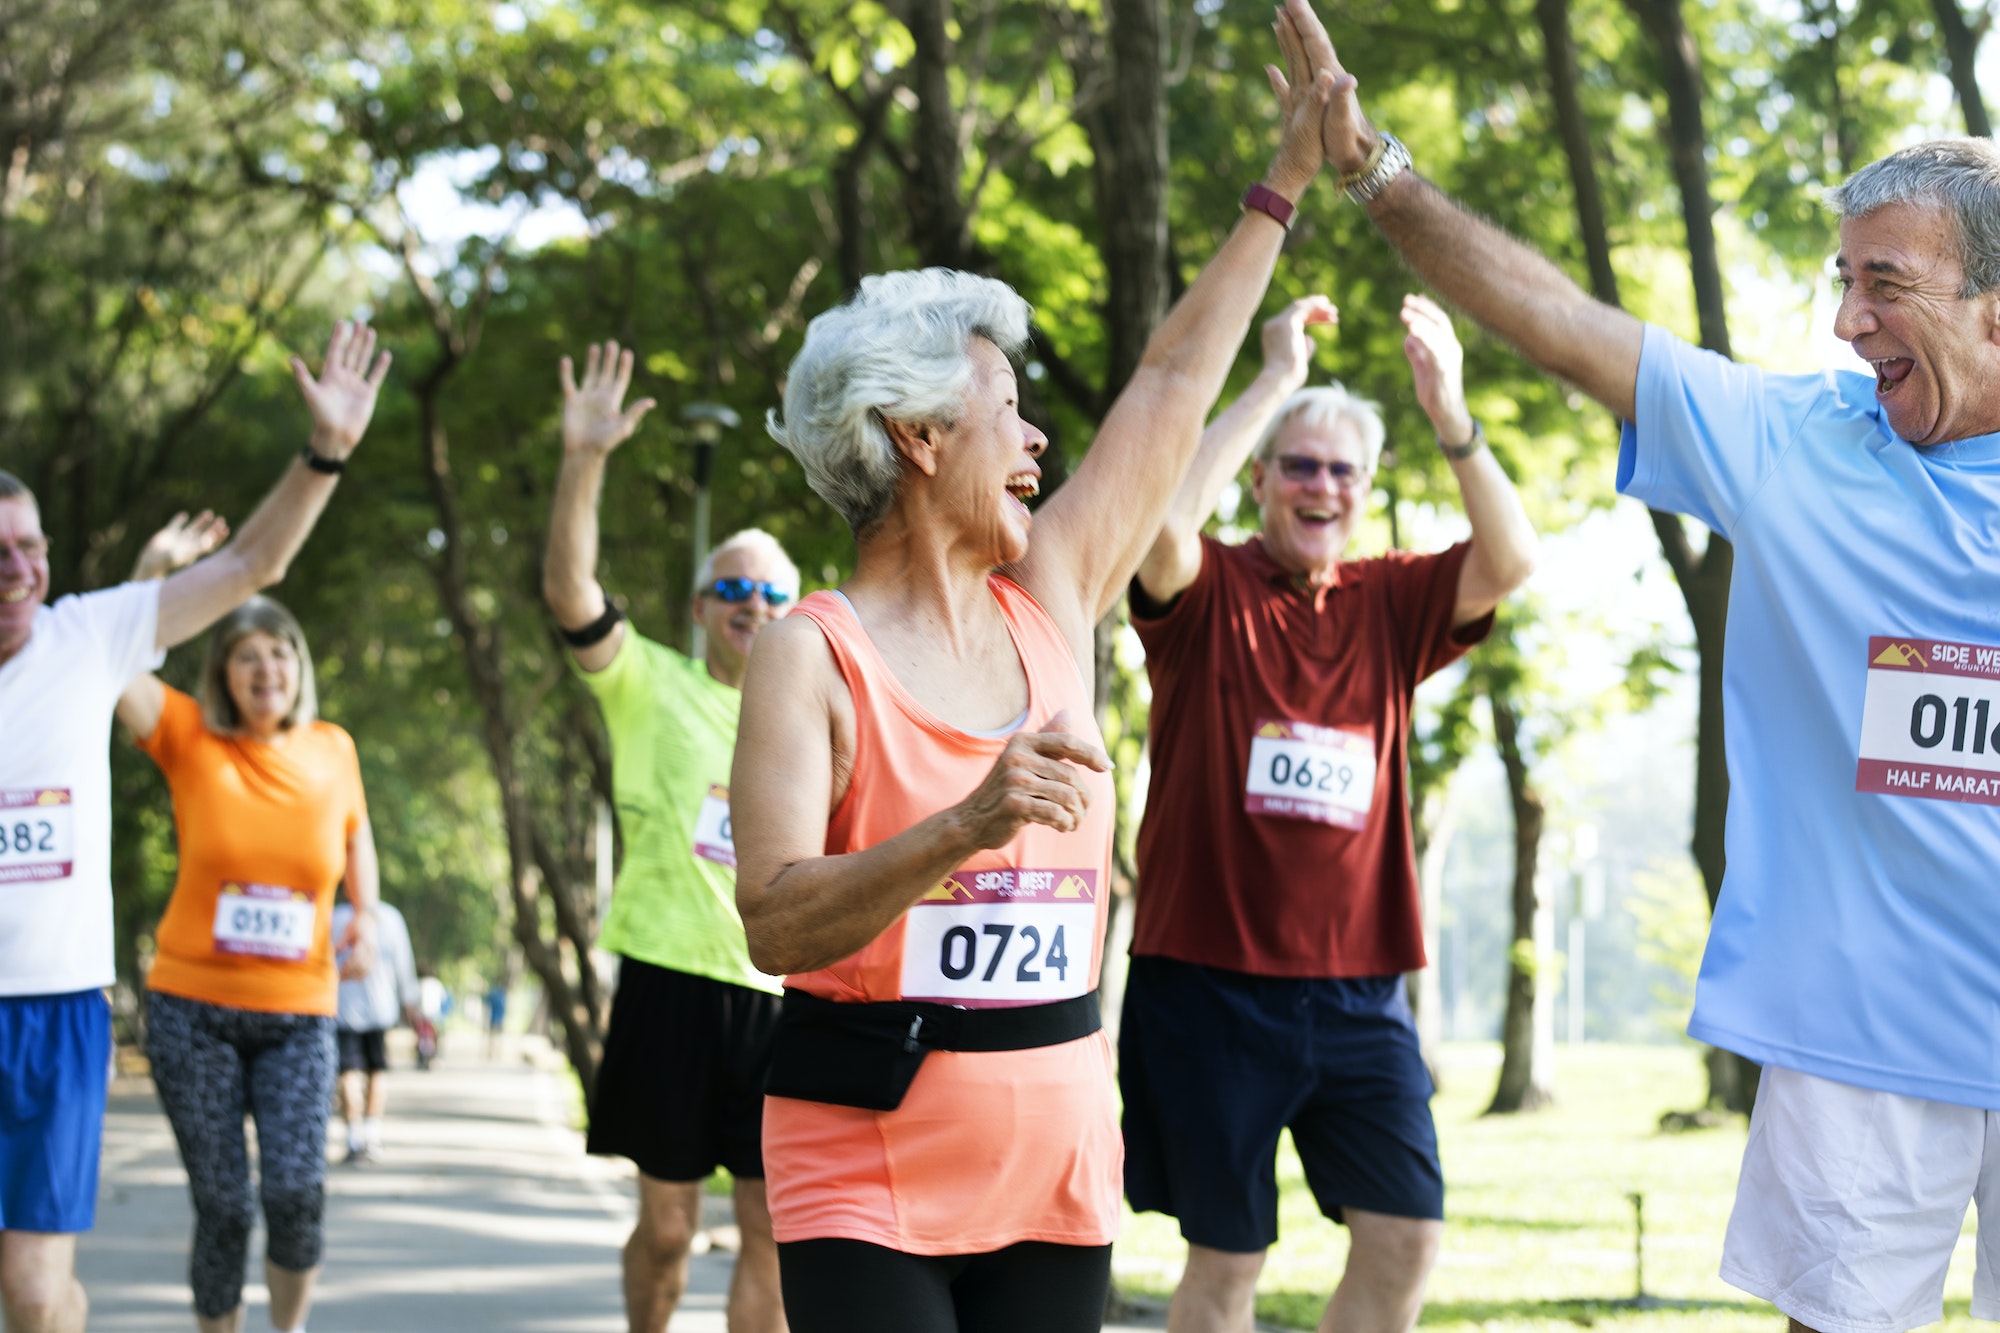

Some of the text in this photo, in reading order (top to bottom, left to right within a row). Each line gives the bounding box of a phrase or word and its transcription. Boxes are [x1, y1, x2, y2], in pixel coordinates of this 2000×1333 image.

[1931, 644, 1970, 664] SIDE
[1953, 662, 2000, 675] MOUNTAIN
[1271, 753, 1353, 795] 0629
[1886, 768, 2000, 797] HALF MARAT
[974, 871, 1055, 892] SIDE WEST
[940, 923, 1068, 983] 0724
